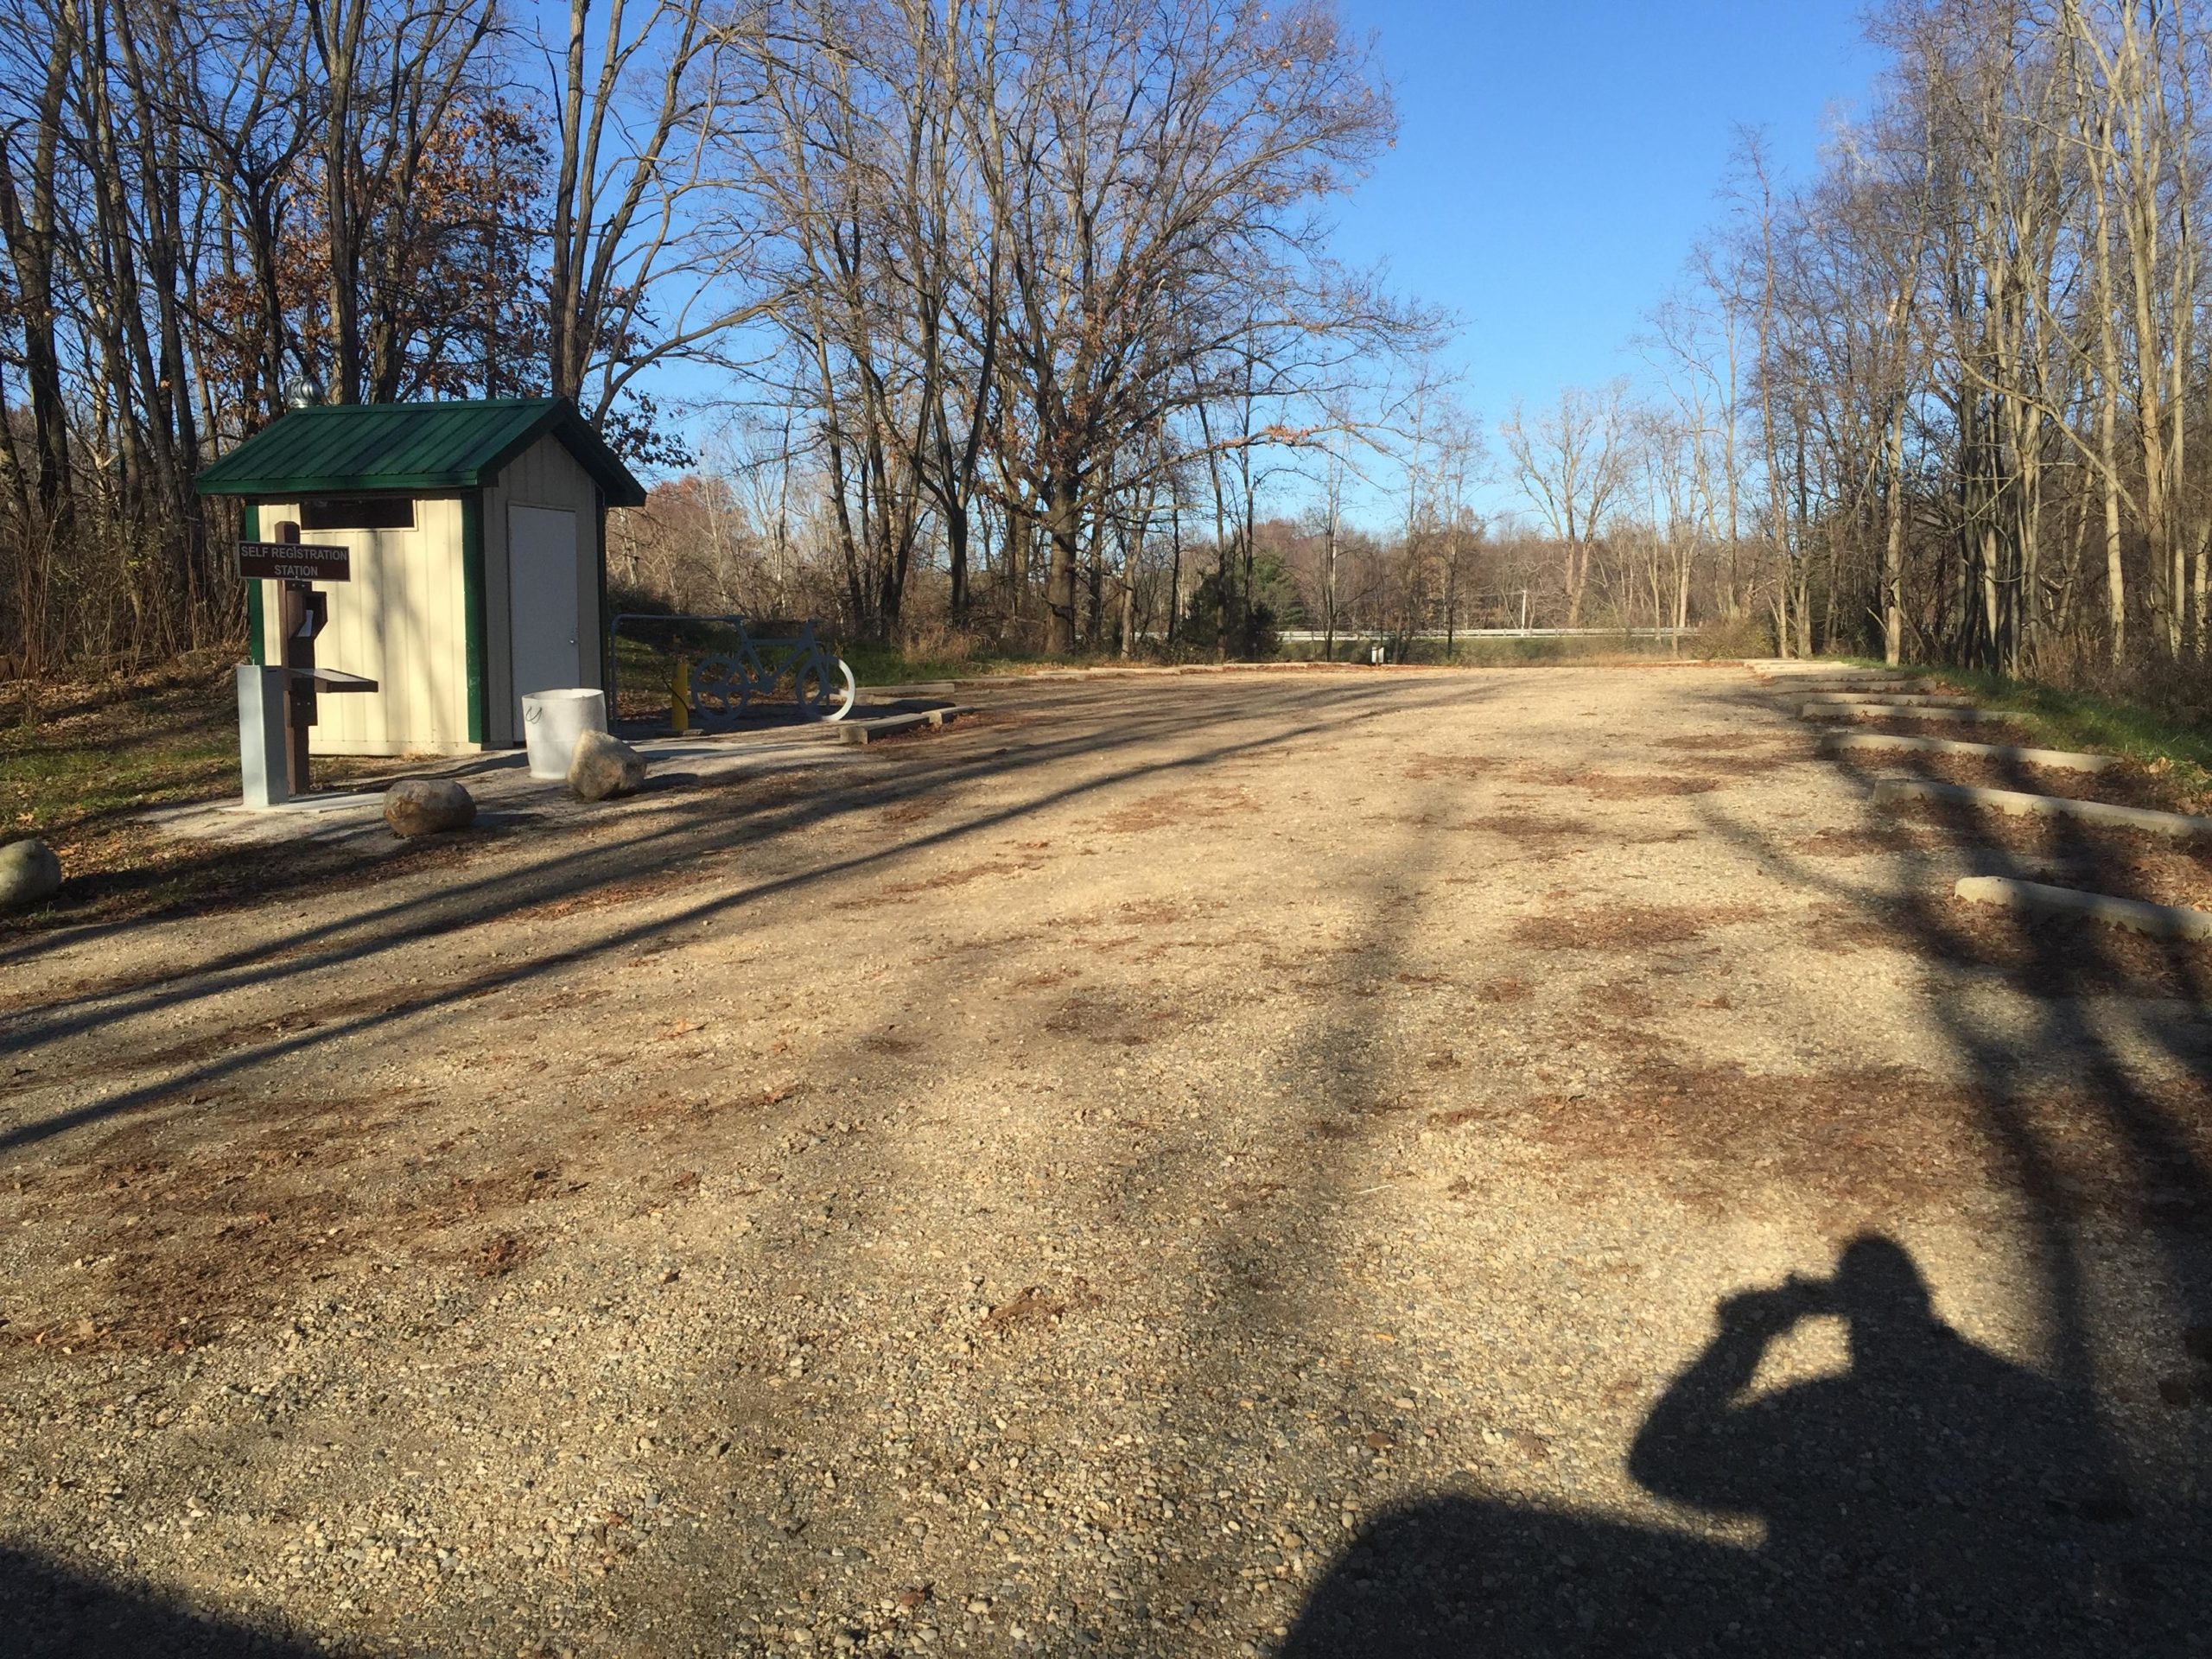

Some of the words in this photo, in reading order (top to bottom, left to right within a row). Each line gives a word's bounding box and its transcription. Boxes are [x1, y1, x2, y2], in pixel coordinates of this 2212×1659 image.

[241, 546, 268, 557] SELF
[271, 547, 346, 560] REGISTRATION
[274, 564, 318, 575] STATION
